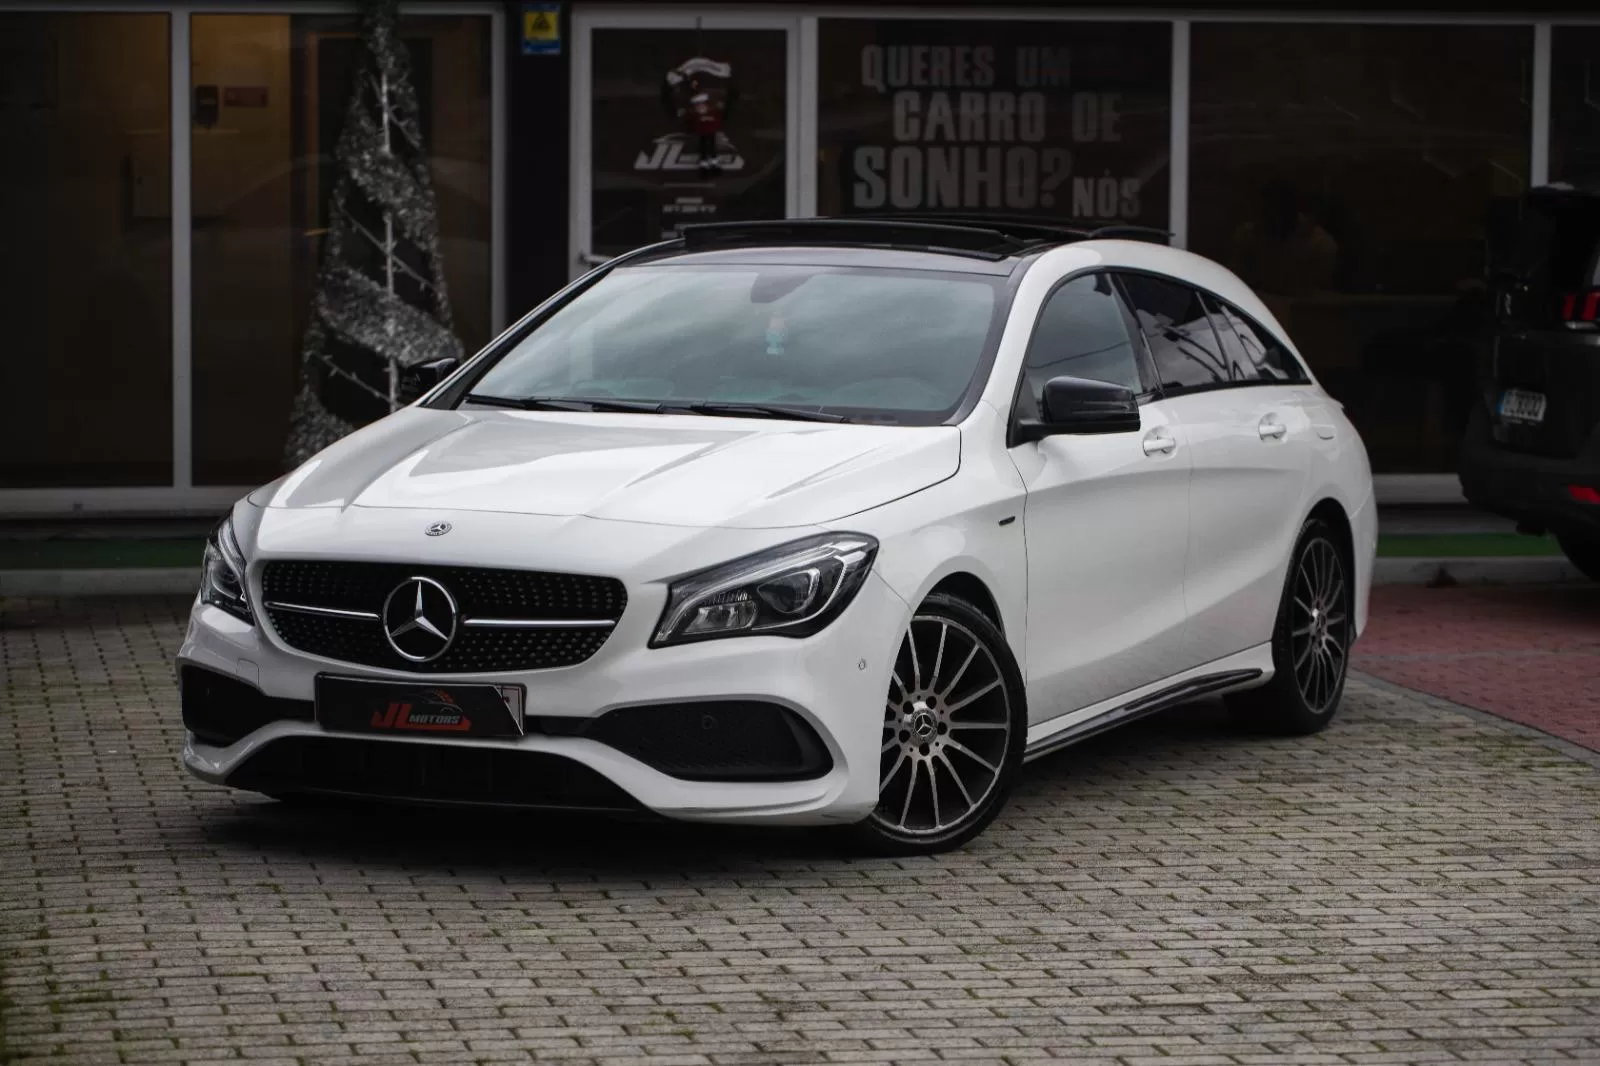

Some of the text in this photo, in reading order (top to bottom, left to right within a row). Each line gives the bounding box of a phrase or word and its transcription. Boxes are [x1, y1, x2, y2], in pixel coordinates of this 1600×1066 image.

[861, 44, 1071, 92] QUERES UM
[892, 90, 1123, 142] CARRO DE
[852, 145, 1073, 209] SONHO?
[1071, 168, 1142, 217] NÓS
[409, 714, 460, 726] MOTORS
